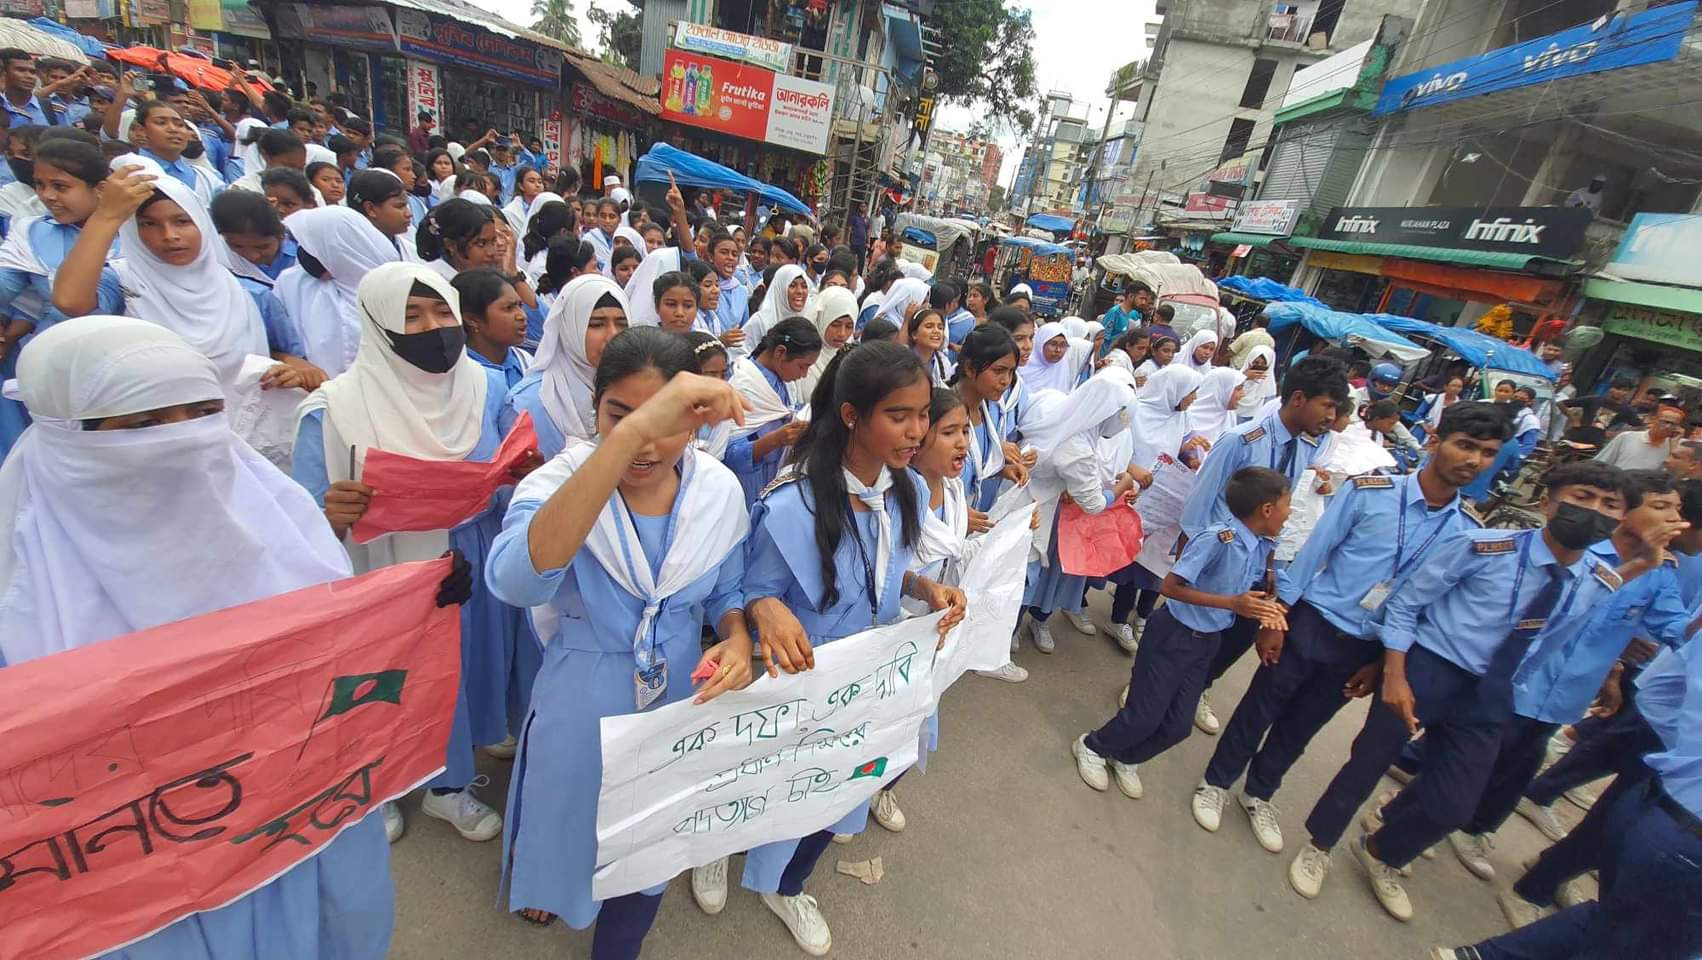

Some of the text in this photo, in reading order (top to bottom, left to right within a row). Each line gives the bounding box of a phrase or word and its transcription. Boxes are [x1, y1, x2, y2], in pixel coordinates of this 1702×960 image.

[722, 82, 766, 101] Frutika
[1416, 72, 1468, 97] vivo
[777, 88, 830, 111] আনারকলি
[1334, 215, 1381, 234] Infinix
[1464, 218, 1547, 244] Infinix
[648, 721, 720, 774] এক
[812, 674, 872, 721] এক
[875, 641, 918, 699] দাবি
[672, 766, 841, 833] পদত্যাগ চাই
[0, 751, 385, 892] মানতে হবে
